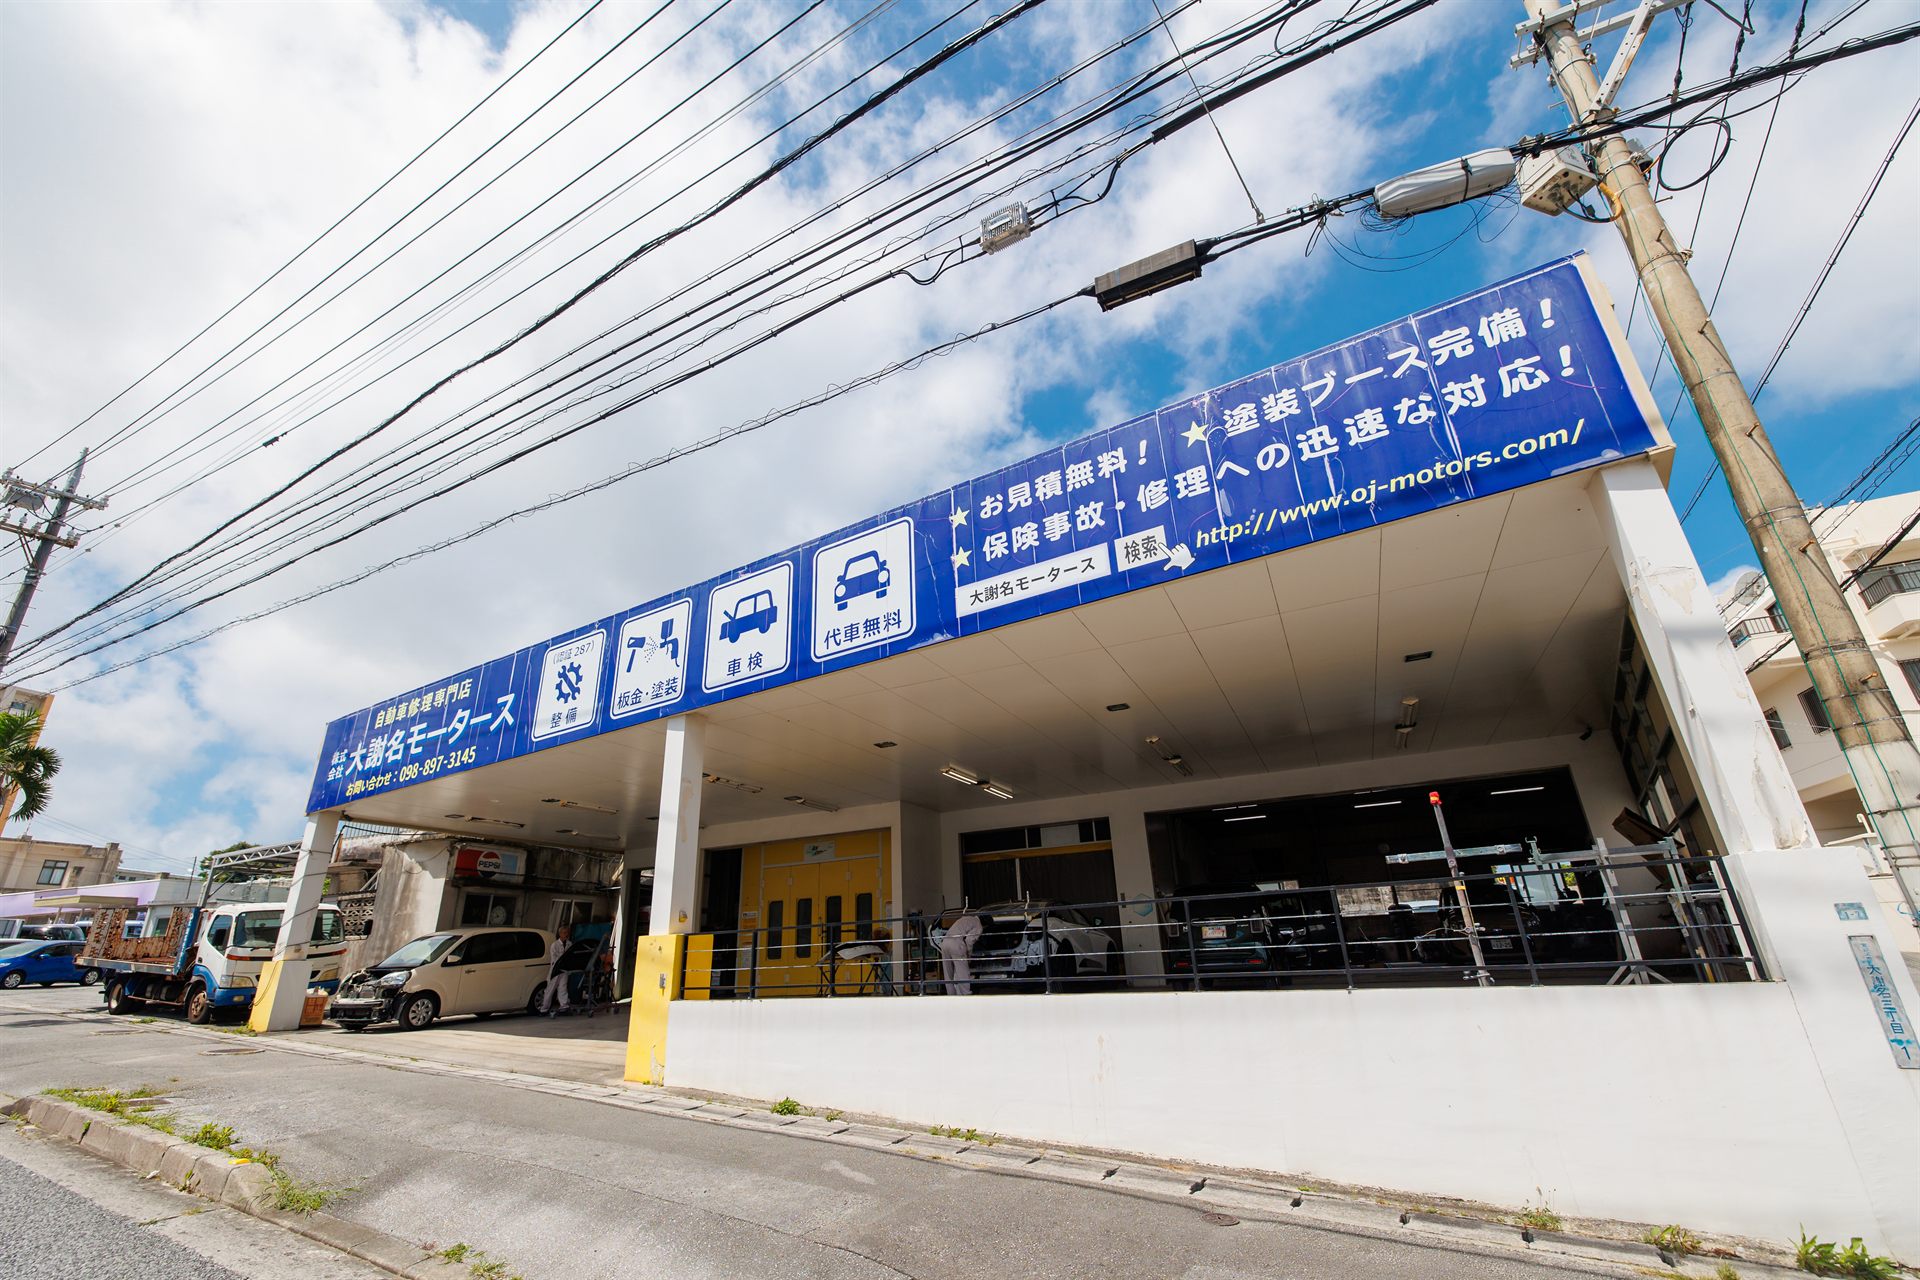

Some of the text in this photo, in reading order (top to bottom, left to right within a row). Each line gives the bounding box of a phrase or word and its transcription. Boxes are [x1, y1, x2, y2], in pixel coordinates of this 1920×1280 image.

[1223, 298, 1556, 438] 塗装ブース完備！
[982, 344, 1576, 563] 保険事故・修理への迅速な対応！
[979, 439, 1148, 519] お見積無料！
[1196, 418, 1585, 548] http://www.oj-motors.com/
[1124, 534, 1160, 565] 検索
[969, 557, 1096, 607] 大謝名モータース
[824, 608, 902, 650] 代車無料
[726, 651, 763, 677] 車検
[374, 678, 473, 729] 自動車修理専門店
[616, 676, 679, 710] 板金・塗装
[345, 692, 515, 776] 大謝名モータース
[478, 860, 501, 869] PEPSI
